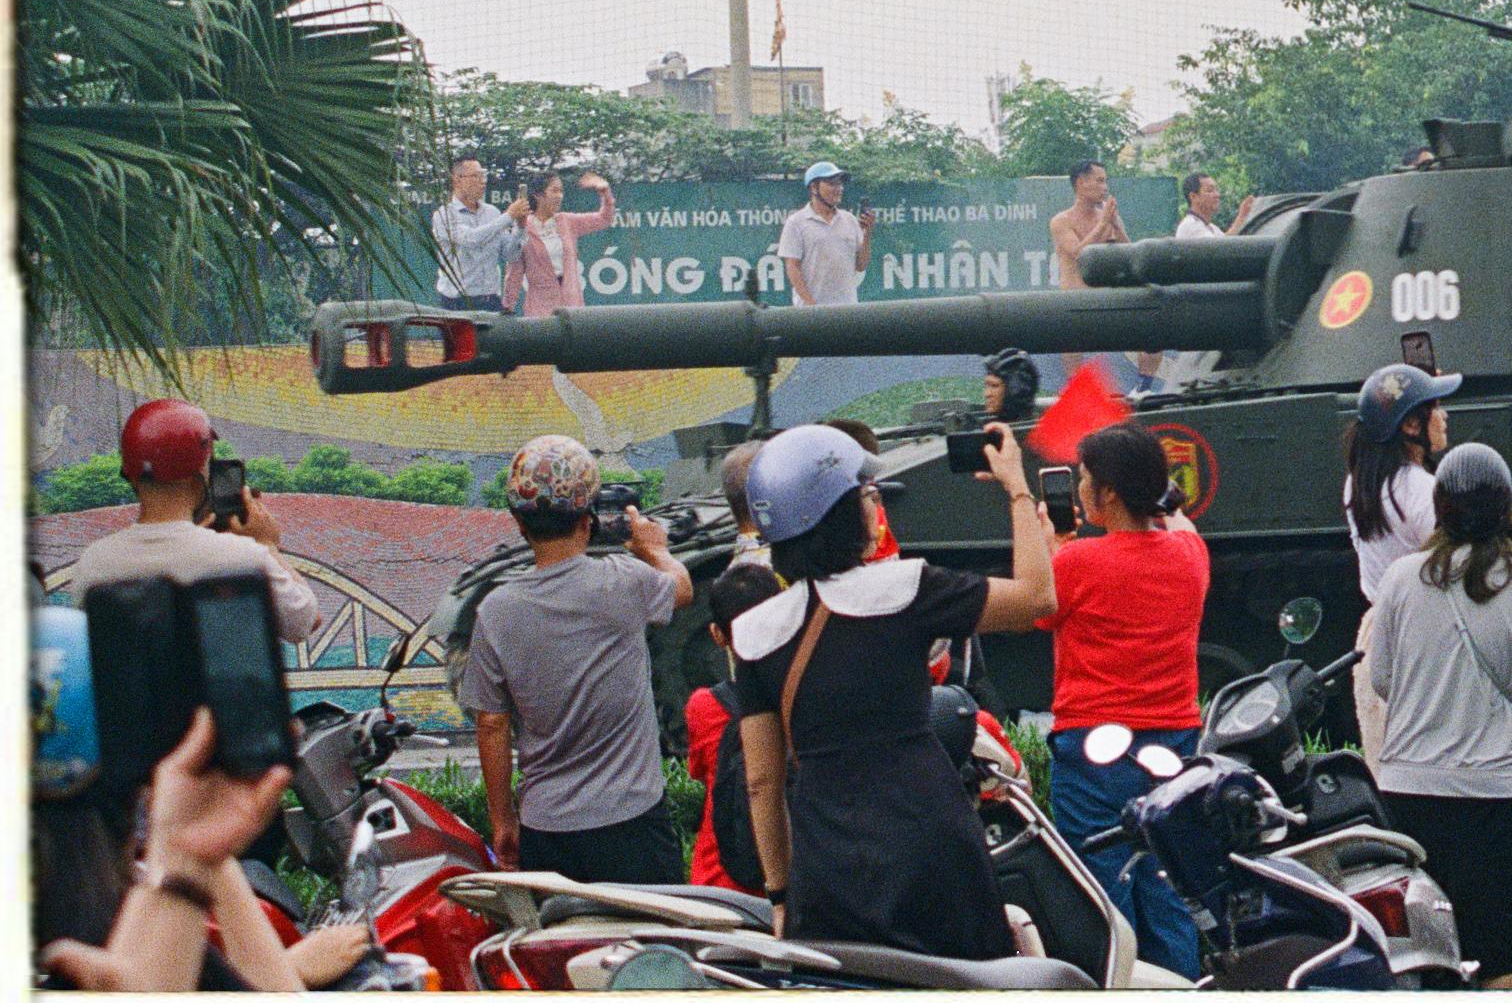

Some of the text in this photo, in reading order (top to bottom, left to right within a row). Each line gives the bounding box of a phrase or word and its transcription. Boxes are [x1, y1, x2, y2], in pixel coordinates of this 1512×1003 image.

[611, 207, 641, 228] ÂM
[646, 206, 688, 228] VĂN
[692, 205, 733, 227] HÓA
[911, 205, 961, 223] THAO
[965, 204, 990, 223] BA
[994, 200, 1038, 221] ĐÌNH
[882, 239, 1009, 290] NHÂN
[1391, 269, 1461, 323] 006
